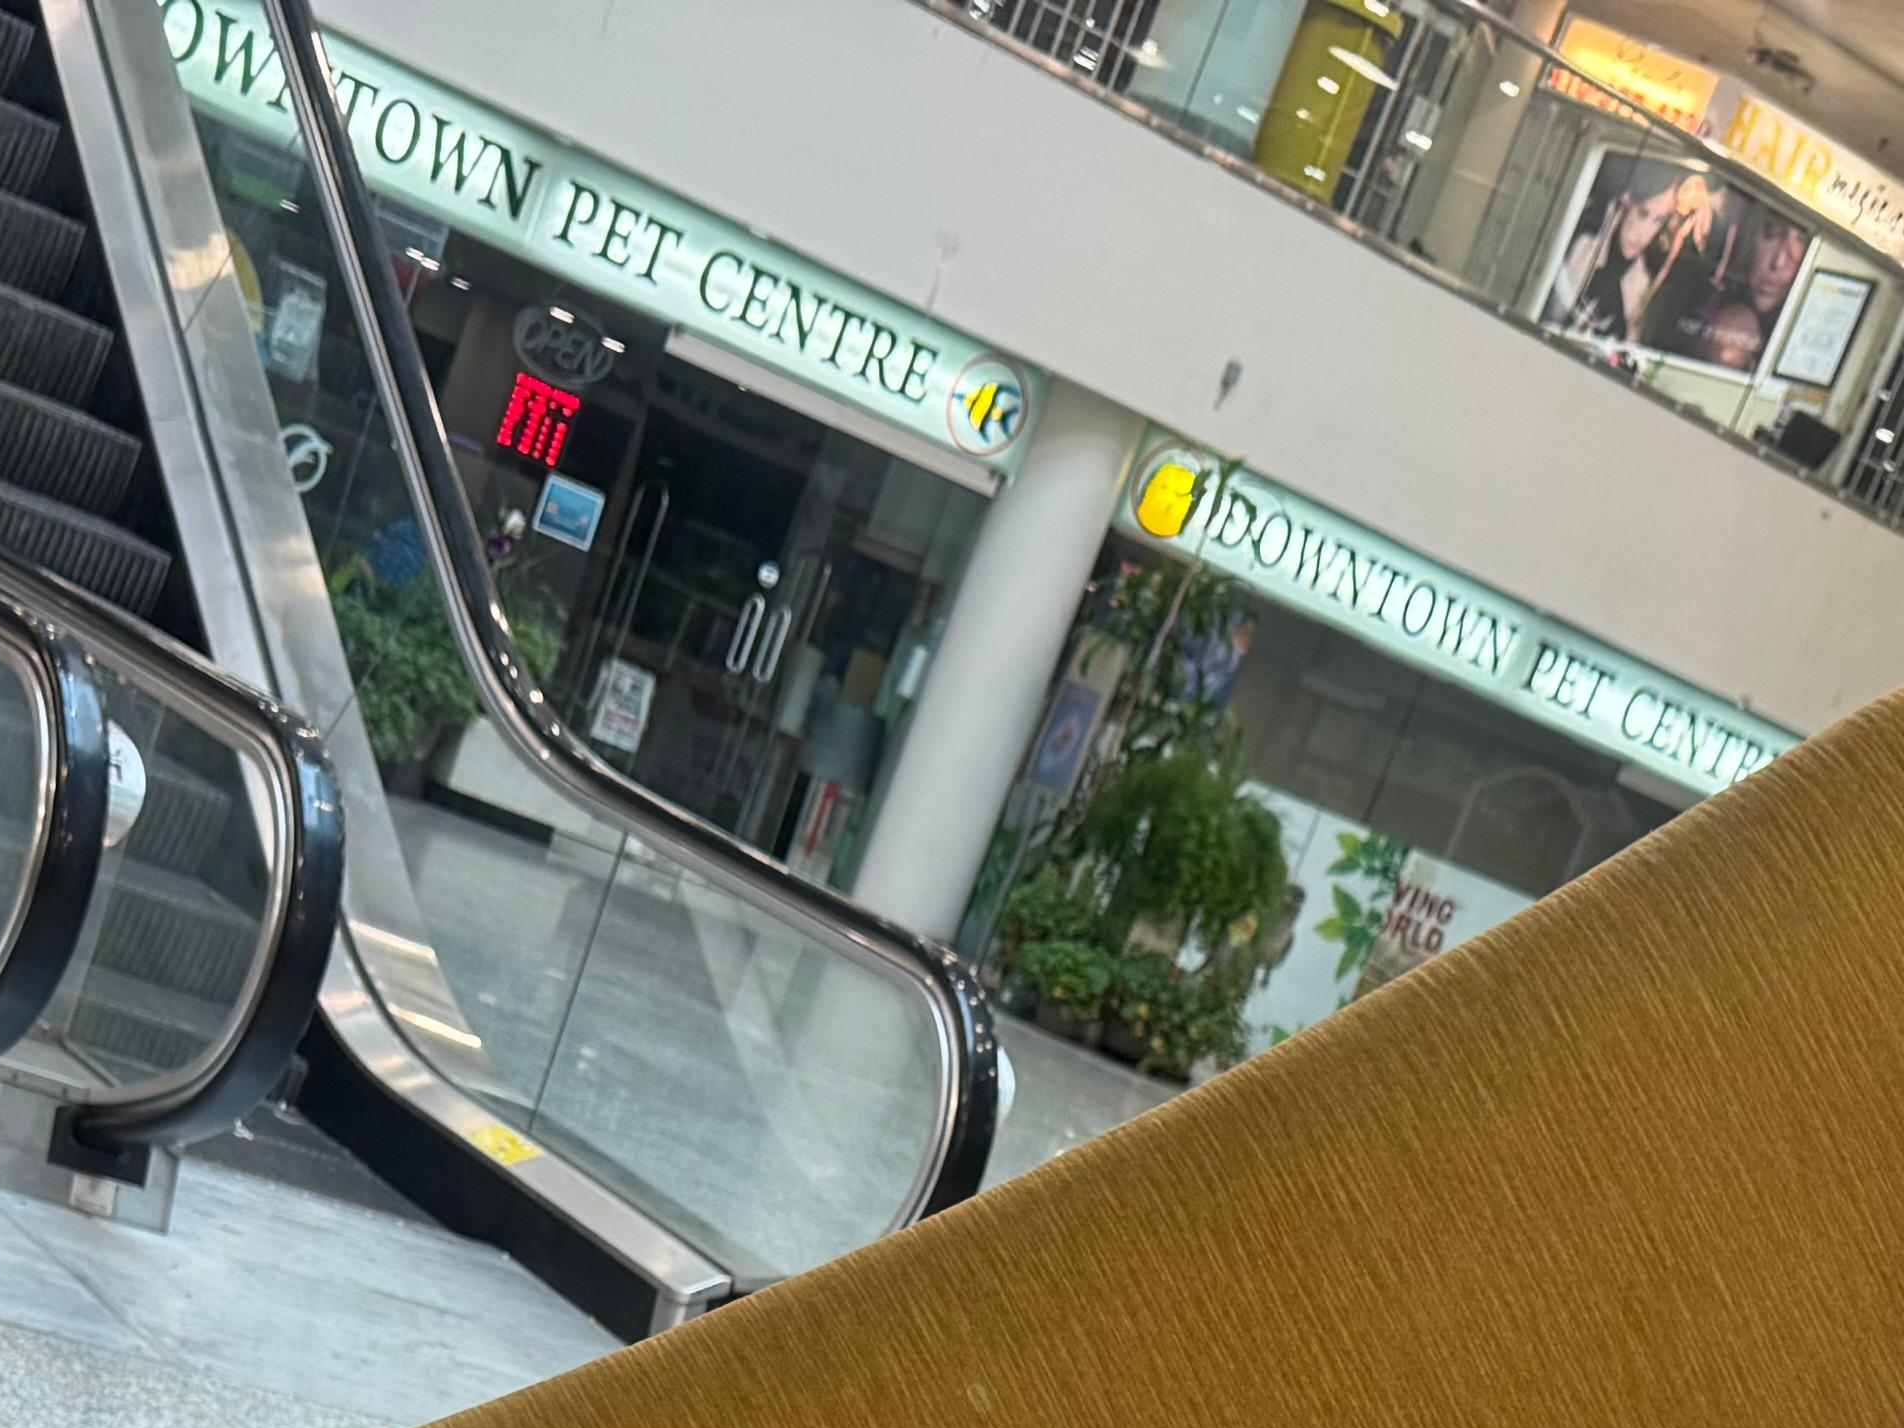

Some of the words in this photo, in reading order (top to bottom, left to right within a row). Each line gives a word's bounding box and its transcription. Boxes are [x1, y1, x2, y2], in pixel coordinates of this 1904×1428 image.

[1725, 96, 1834, 194] HAIR
[161, 0, 542, 221] OWTOWN
[553, 178, 685, 287] PET
[698, 249, 939, 405] CENTRE
[521, 320, 605, 377] OPEN
[1211, 489, 1520, 676] DOWNTOWN
[1521, 640, 1617, 721] PET
[1621, 686, 1782, 785] CENTR
[1380, 909, 1444, 957] RLD
[1395, 884, 1454, 926] VING
